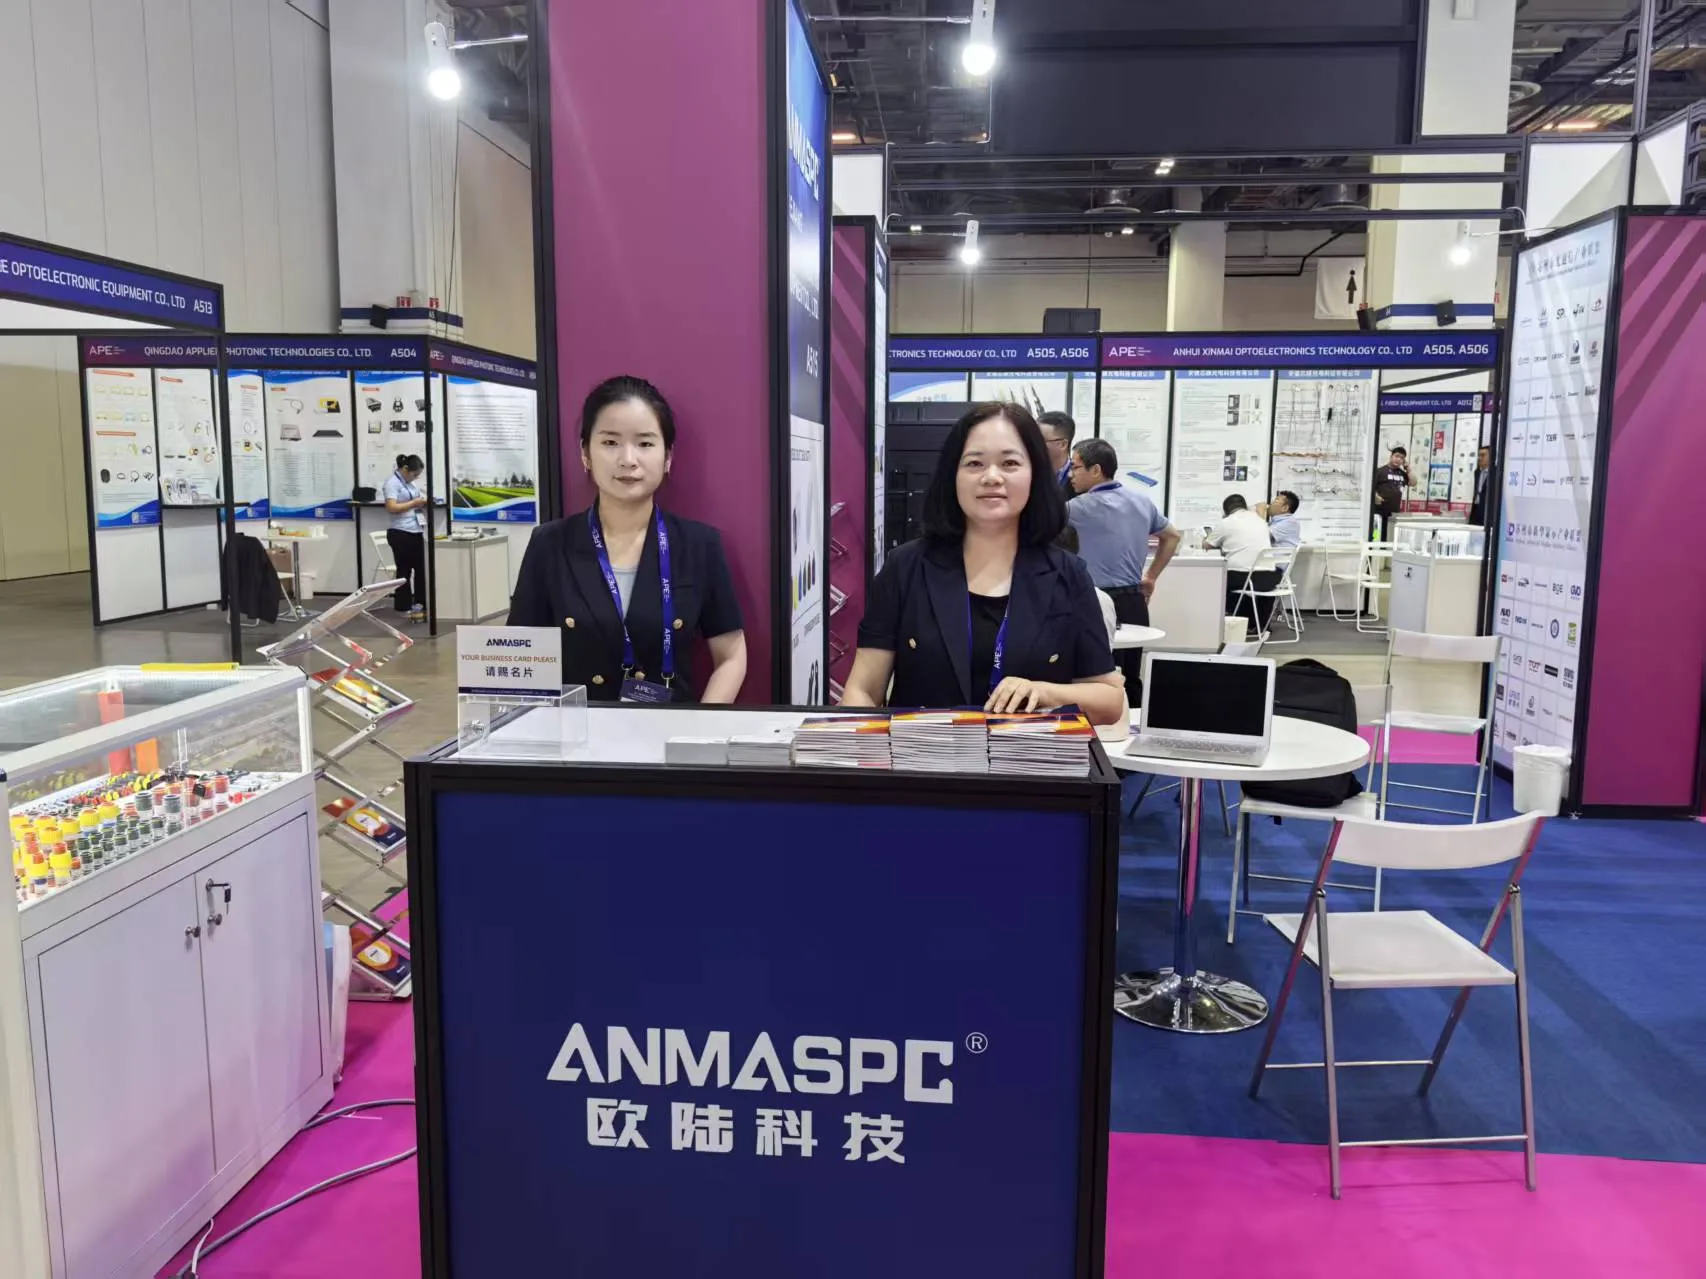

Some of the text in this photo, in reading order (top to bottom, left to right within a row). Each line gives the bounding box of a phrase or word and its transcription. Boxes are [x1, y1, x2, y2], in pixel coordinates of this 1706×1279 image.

[11, 261, 101, 292] OPTOELECTRONIC
[102, 280, 152, 302] EQUIPMENT
[154, 292, 170, 307] CO.,
[171, 295, 186, 308] LTD
[193, 299, 213, 314] A513
[90, 345, 113, 356] APE
[144, 346, 184, 357] QINGDAO
[185, 346, 218, 356] APPLIE
[269, 347, 335, 358] TECHNOLOGIES
[390, 349, 417, 358] A504
[927, 349, 982, 359] TECHNOLOGY
[1001, 350, 1017, 358] LTD
[1027, 347, 1058, 360] A505,
[1060, 347, 1089, 358] A506
[1108, 346, 1137, 357] APE
[1173, 347, 1201, 356] ANHUI
[1202, 347, 1233, 356] XINMAI
[1235, 347, 1316, 356] OPTOELECTRONICS
[1317, 346, 1375, 355] TECHNOLOGY
[1395, 346, 1413, 355] LTD
[1423, 344, 1456, 357] A505,
[1458, 344, 1489, 355] A506
[659, 531, 669, 550] APE
[662, 577, 671, 595] APE
[486, 638, 532, 648] ANMASPC
[664, 628, 672, 647] APE
[992, 650, 1002, 669] APE
[546, 1022, 954, 1104] ANMASPC
[586, 1097, 905, 1164] 欧陆科技
